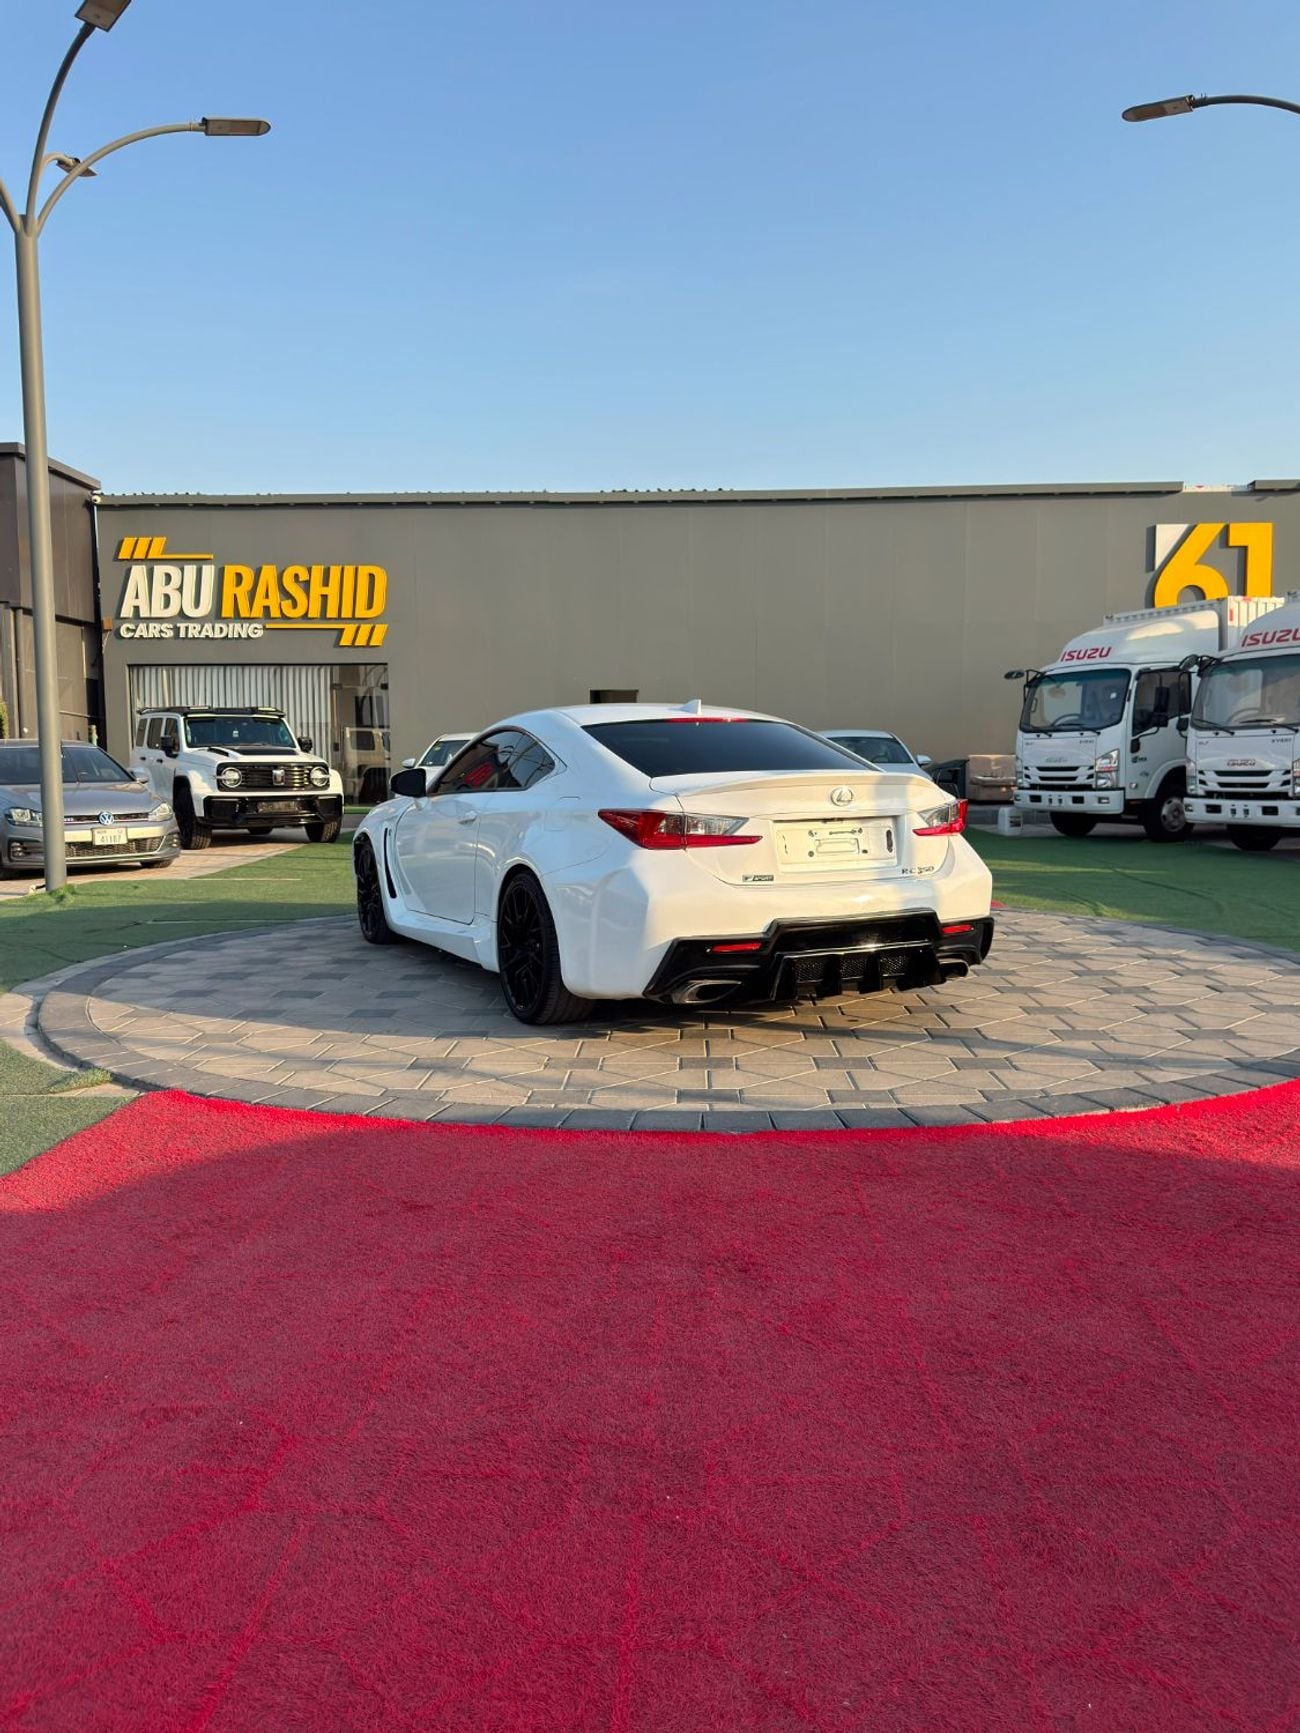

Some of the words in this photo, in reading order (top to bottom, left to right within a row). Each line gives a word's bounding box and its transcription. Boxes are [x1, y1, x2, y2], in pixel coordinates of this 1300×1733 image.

[1154, 522, 1273, 608] 61
[120, 564, 215, 618] ABU
[221, 564, 388, 618] RASHID
[119, 622, 173, 638] CARS
[176, 622, 263, 639] TRADING
[1060, 646, 1112, 662] ISUZU
